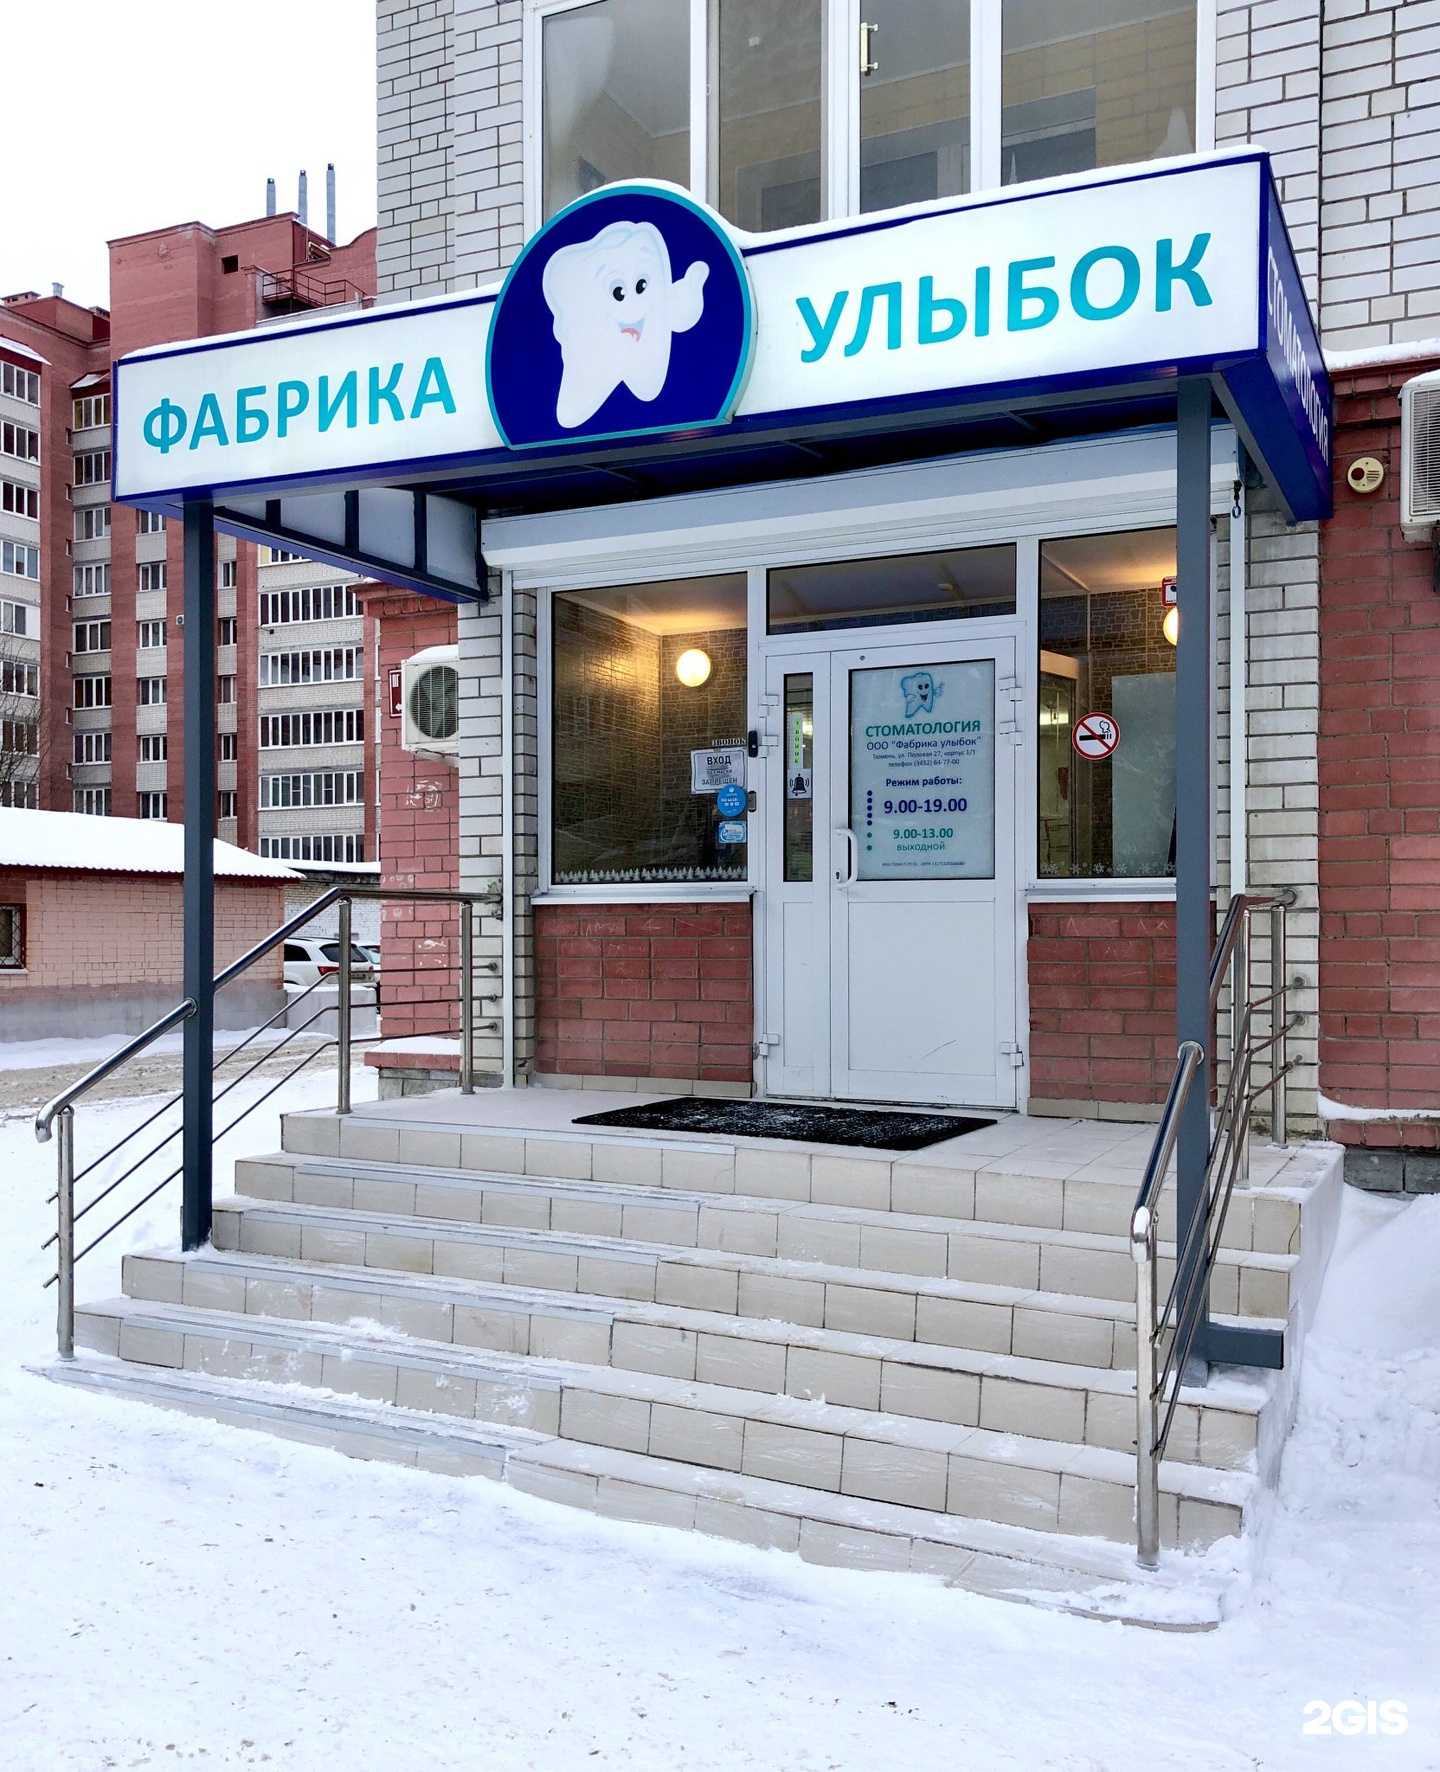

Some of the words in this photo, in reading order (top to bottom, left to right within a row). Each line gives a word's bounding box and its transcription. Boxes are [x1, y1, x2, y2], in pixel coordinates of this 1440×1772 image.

[143, 356, 457, 454] ФАБРИКА
[796, 232, 1213, 363] УЛЫБОК
[1267, 247, 1329, 467] СТОМАТОЛОГИЯ
[865, 720, 981, 738] СТОМАТОЛОГИЯ
[866, 741, 889, 751] ООО
[891, 738, 938, 750] "Фабрика
[706, 755, 732, 766] ВХОД
[885, 777, 920, 788] Режим
[922, 776, 963, 789] работы:
[883, 798, 968, 814] 9.00-19.00
[893, 828, 954, 840] 9.00-13.00
